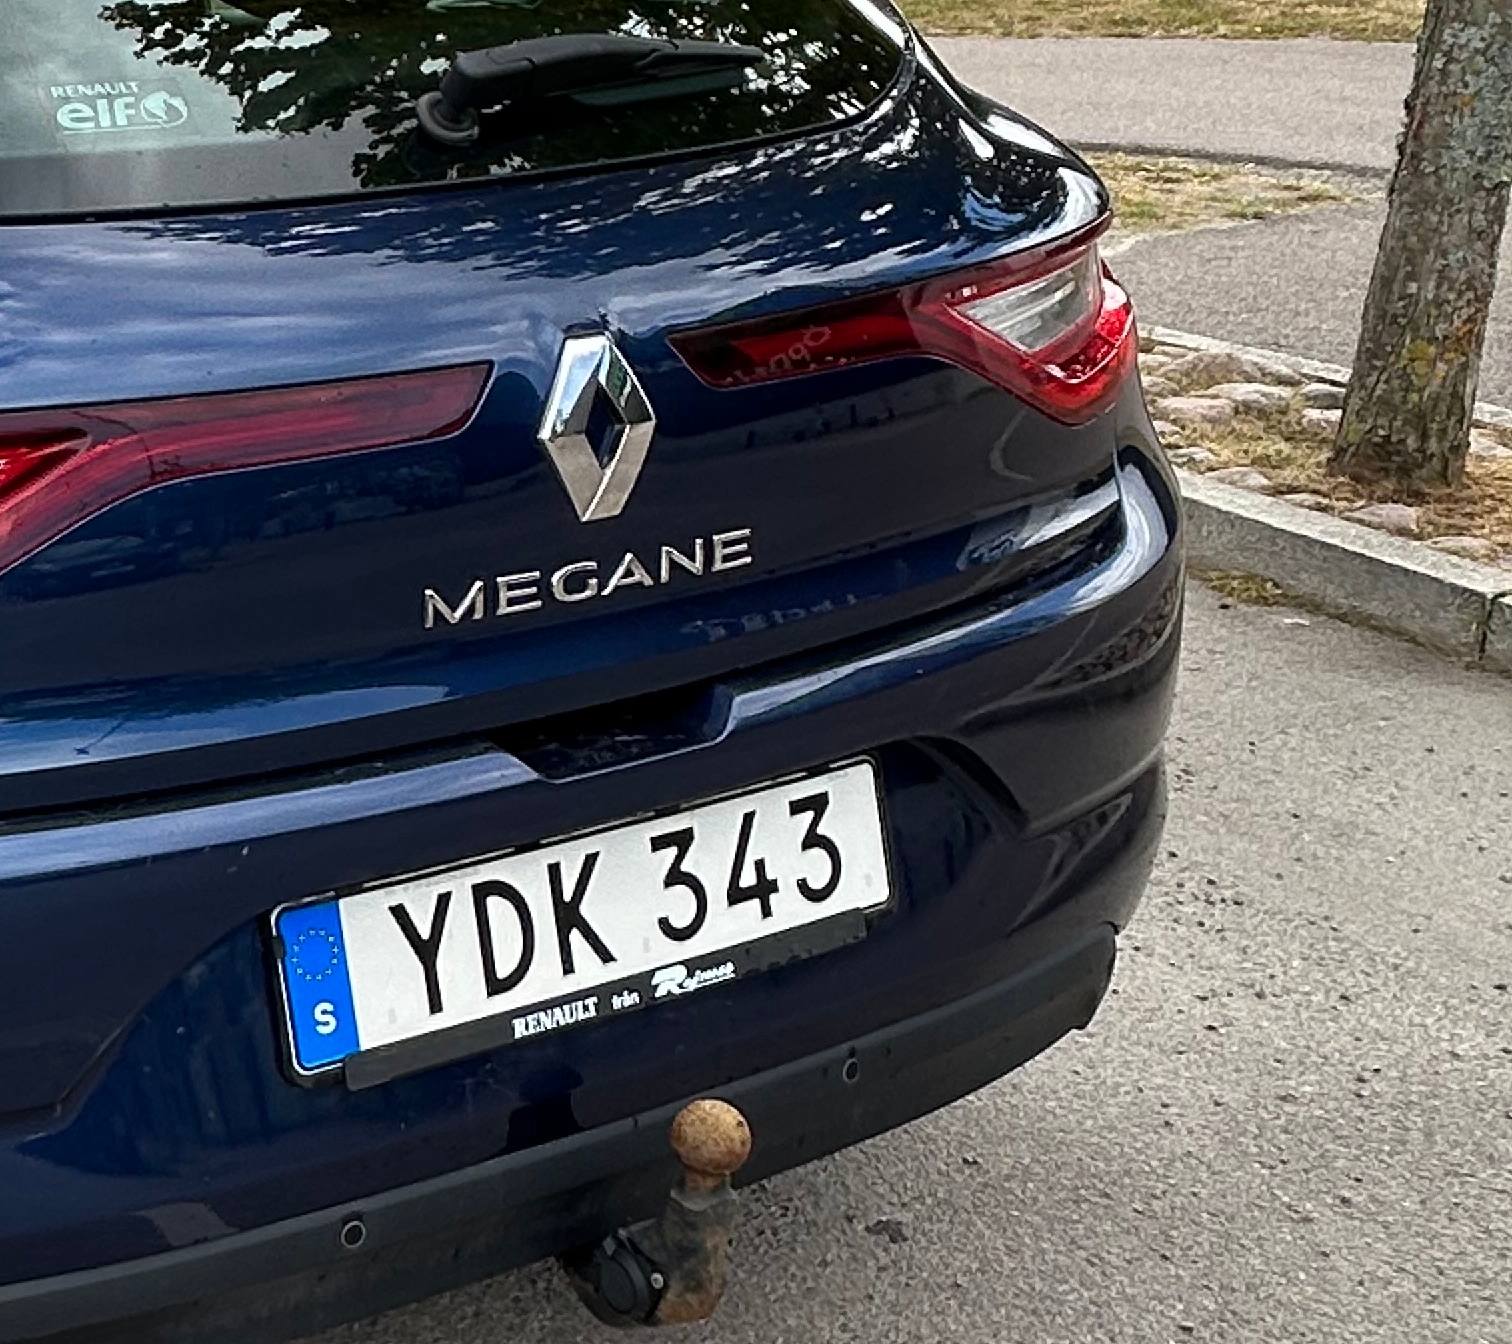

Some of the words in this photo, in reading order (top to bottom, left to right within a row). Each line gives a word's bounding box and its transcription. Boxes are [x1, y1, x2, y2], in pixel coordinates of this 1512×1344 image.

[51, 81, 138, 97] RENAULT
[57, 97, 136, 128] elf
[424, 528, 752, 629] MEGANE
[388, 852, 617, 1015] YDK
[650, 792, 843, 942] 343
[315, 1003, 337, 1034] S
[512, 997, 598, 1039] RENAULT
[611, 989, 640, 1009] från
